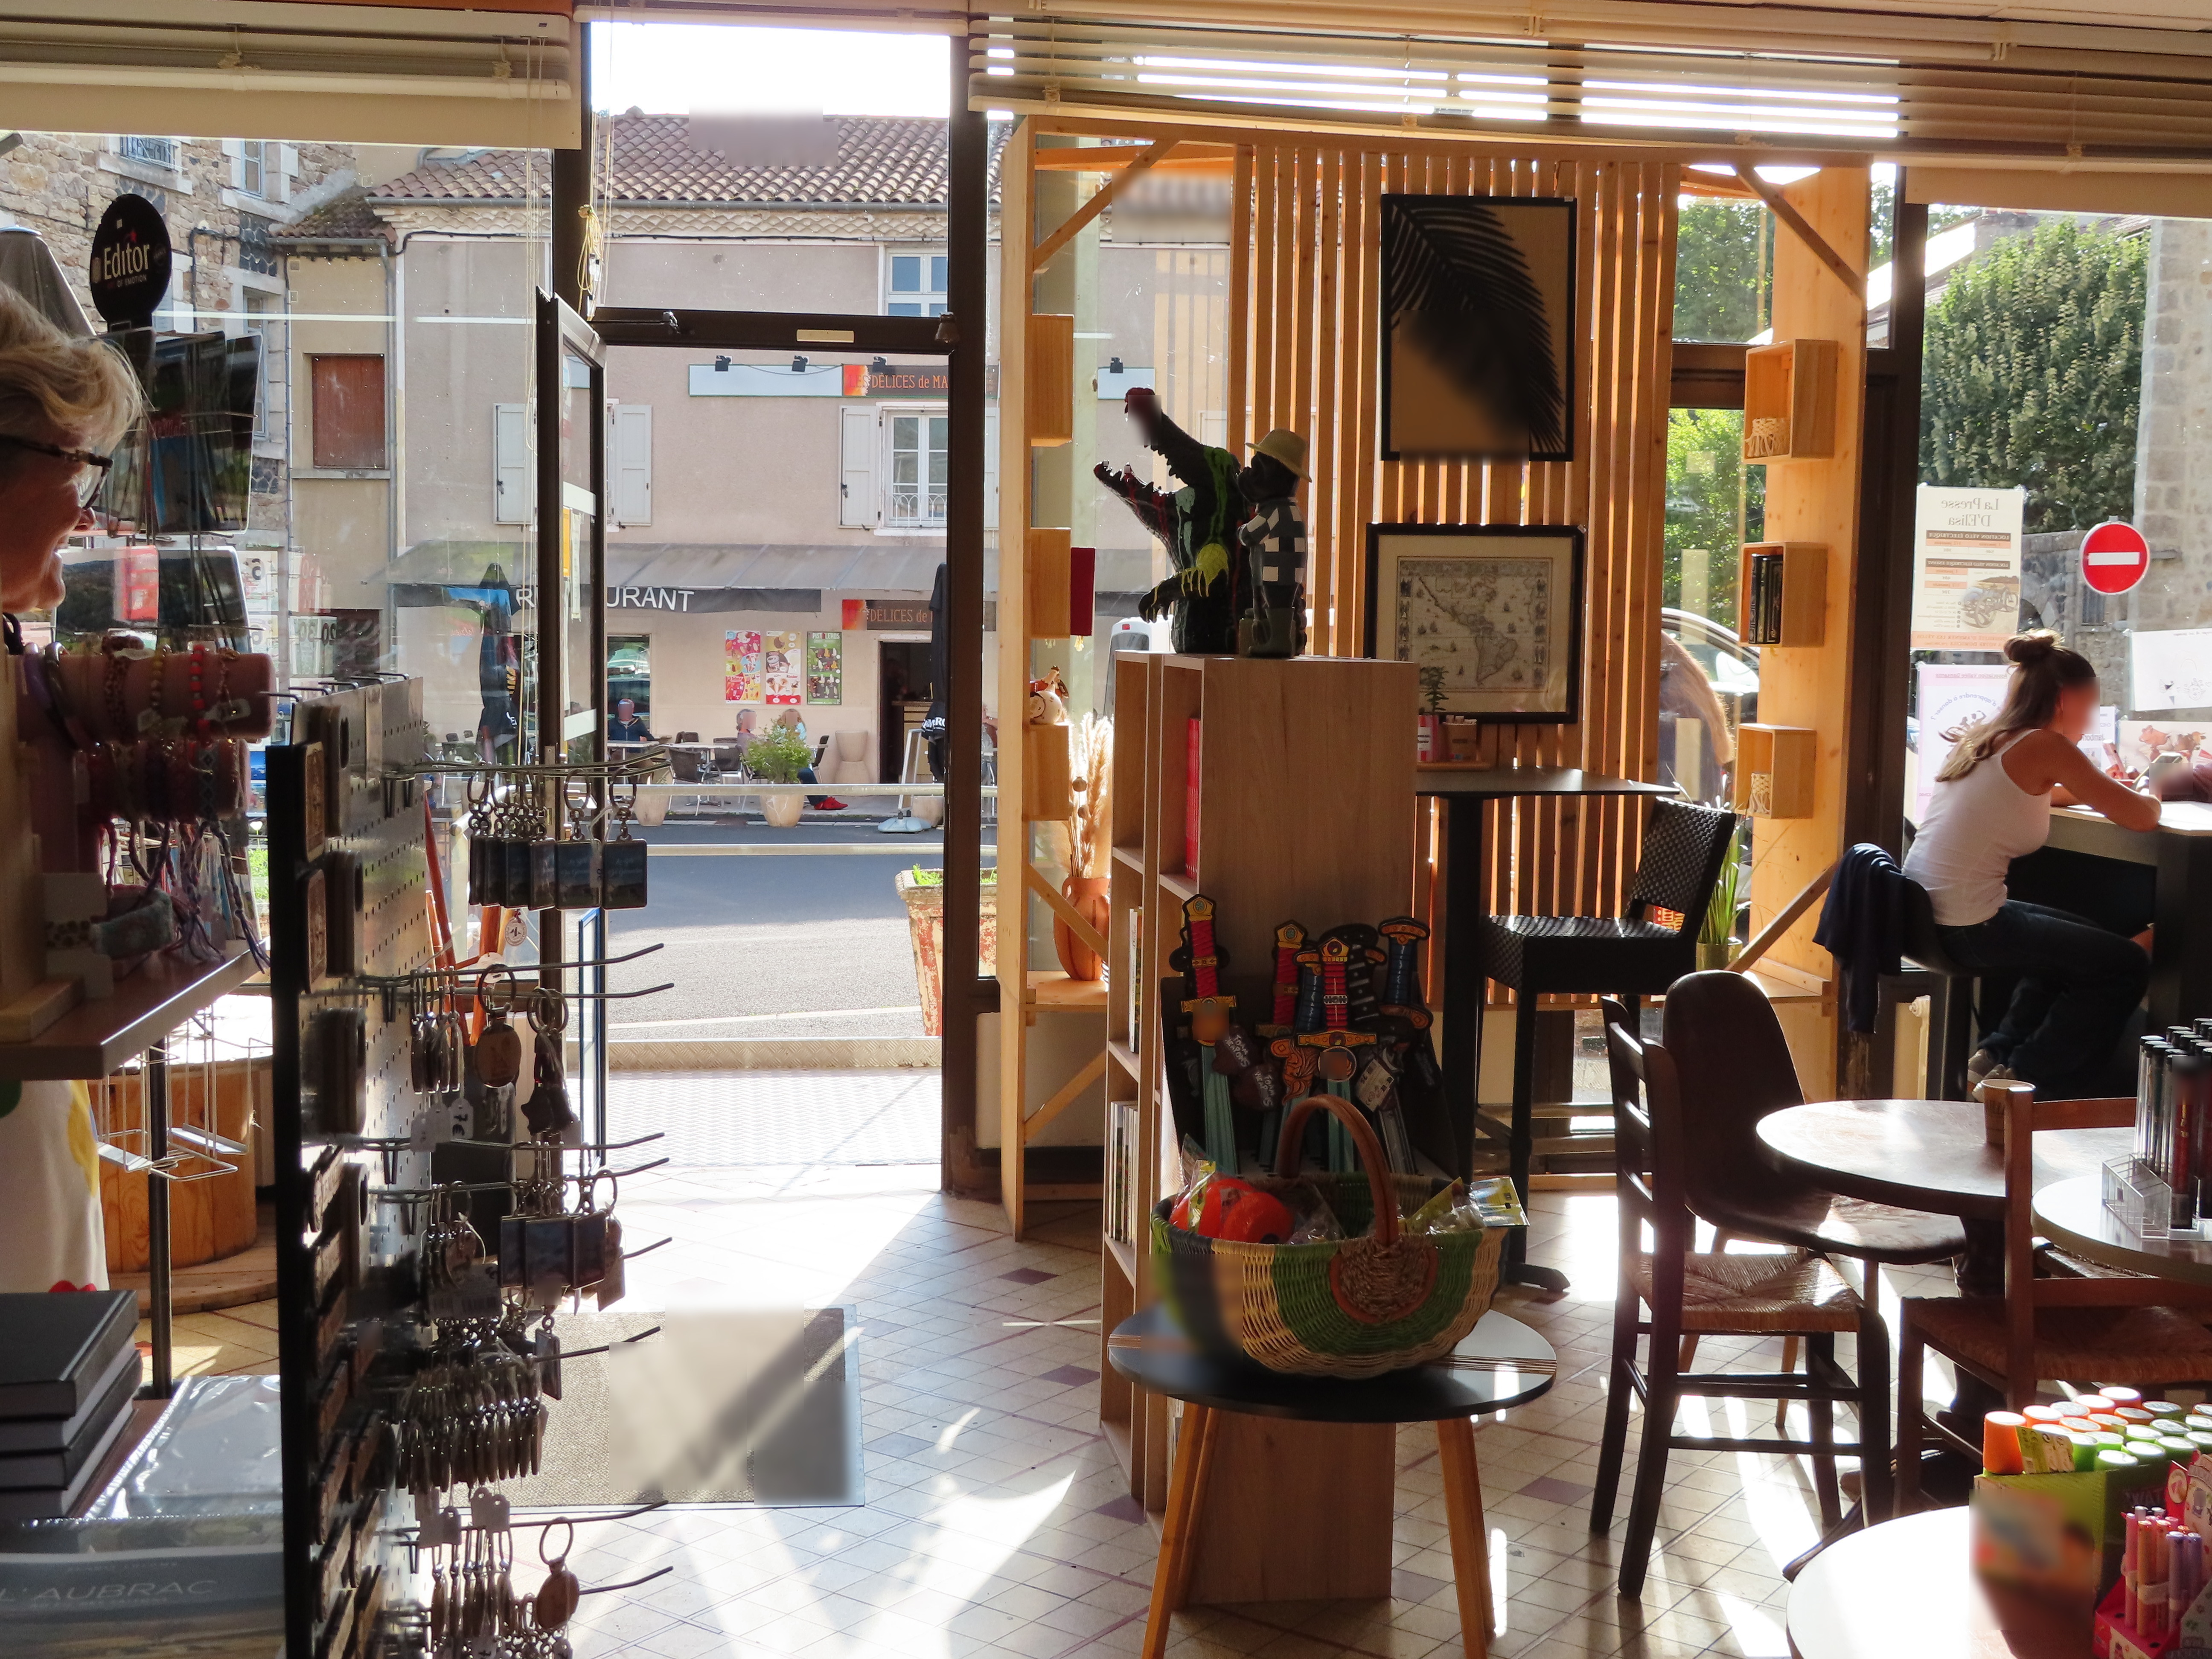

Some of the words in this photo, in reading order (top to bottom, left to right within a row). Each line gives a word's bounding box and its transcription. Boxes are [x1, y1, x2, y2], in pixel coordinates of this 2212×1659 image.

[104, 242, 151, 280] Editor
[117, 279, 123, 288] OF
[125, 275, 148, 286] EMOTION
[872, 373, 915, 388] DÉLICES
[918, 374, 929, 388] de
[932, 375, 948, 388] MA
[870, 607, 913, 622] DÉLICES
[916, 609, 928, 622] de
[0, 1580, 216, 1602] L'AUBRAC
